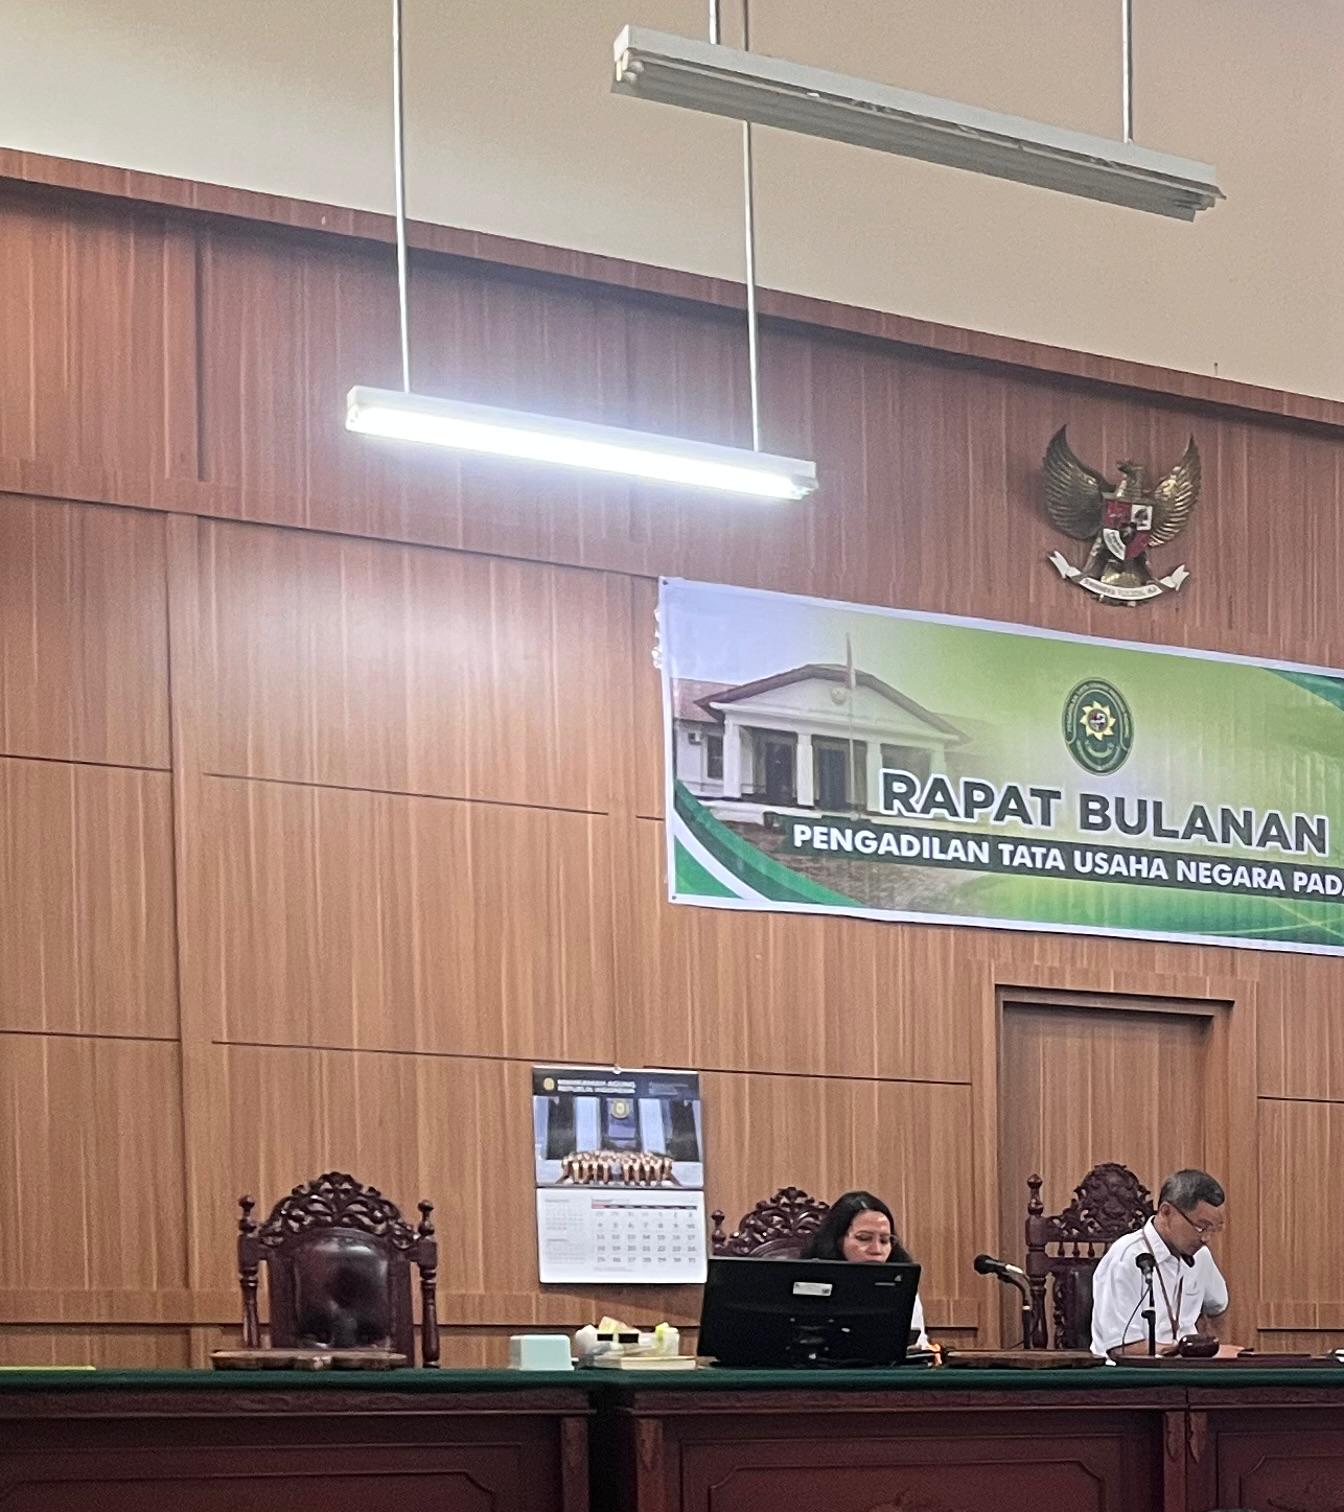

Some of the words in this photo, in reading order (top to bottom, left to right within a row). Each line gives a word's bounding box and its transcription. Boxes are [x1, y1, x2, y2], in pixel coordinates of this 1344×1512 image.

[881, 771, 1063, 827] RAPAT
[1078, 793, 1328, 855] BULANAN
[793, 824, 990, 865] PENGADILAN
[997, 843, 1066, 871] TATA
[1073, 848, 1169, 881] USAHA
[1176, 860, 1286, 892] NEGARA
